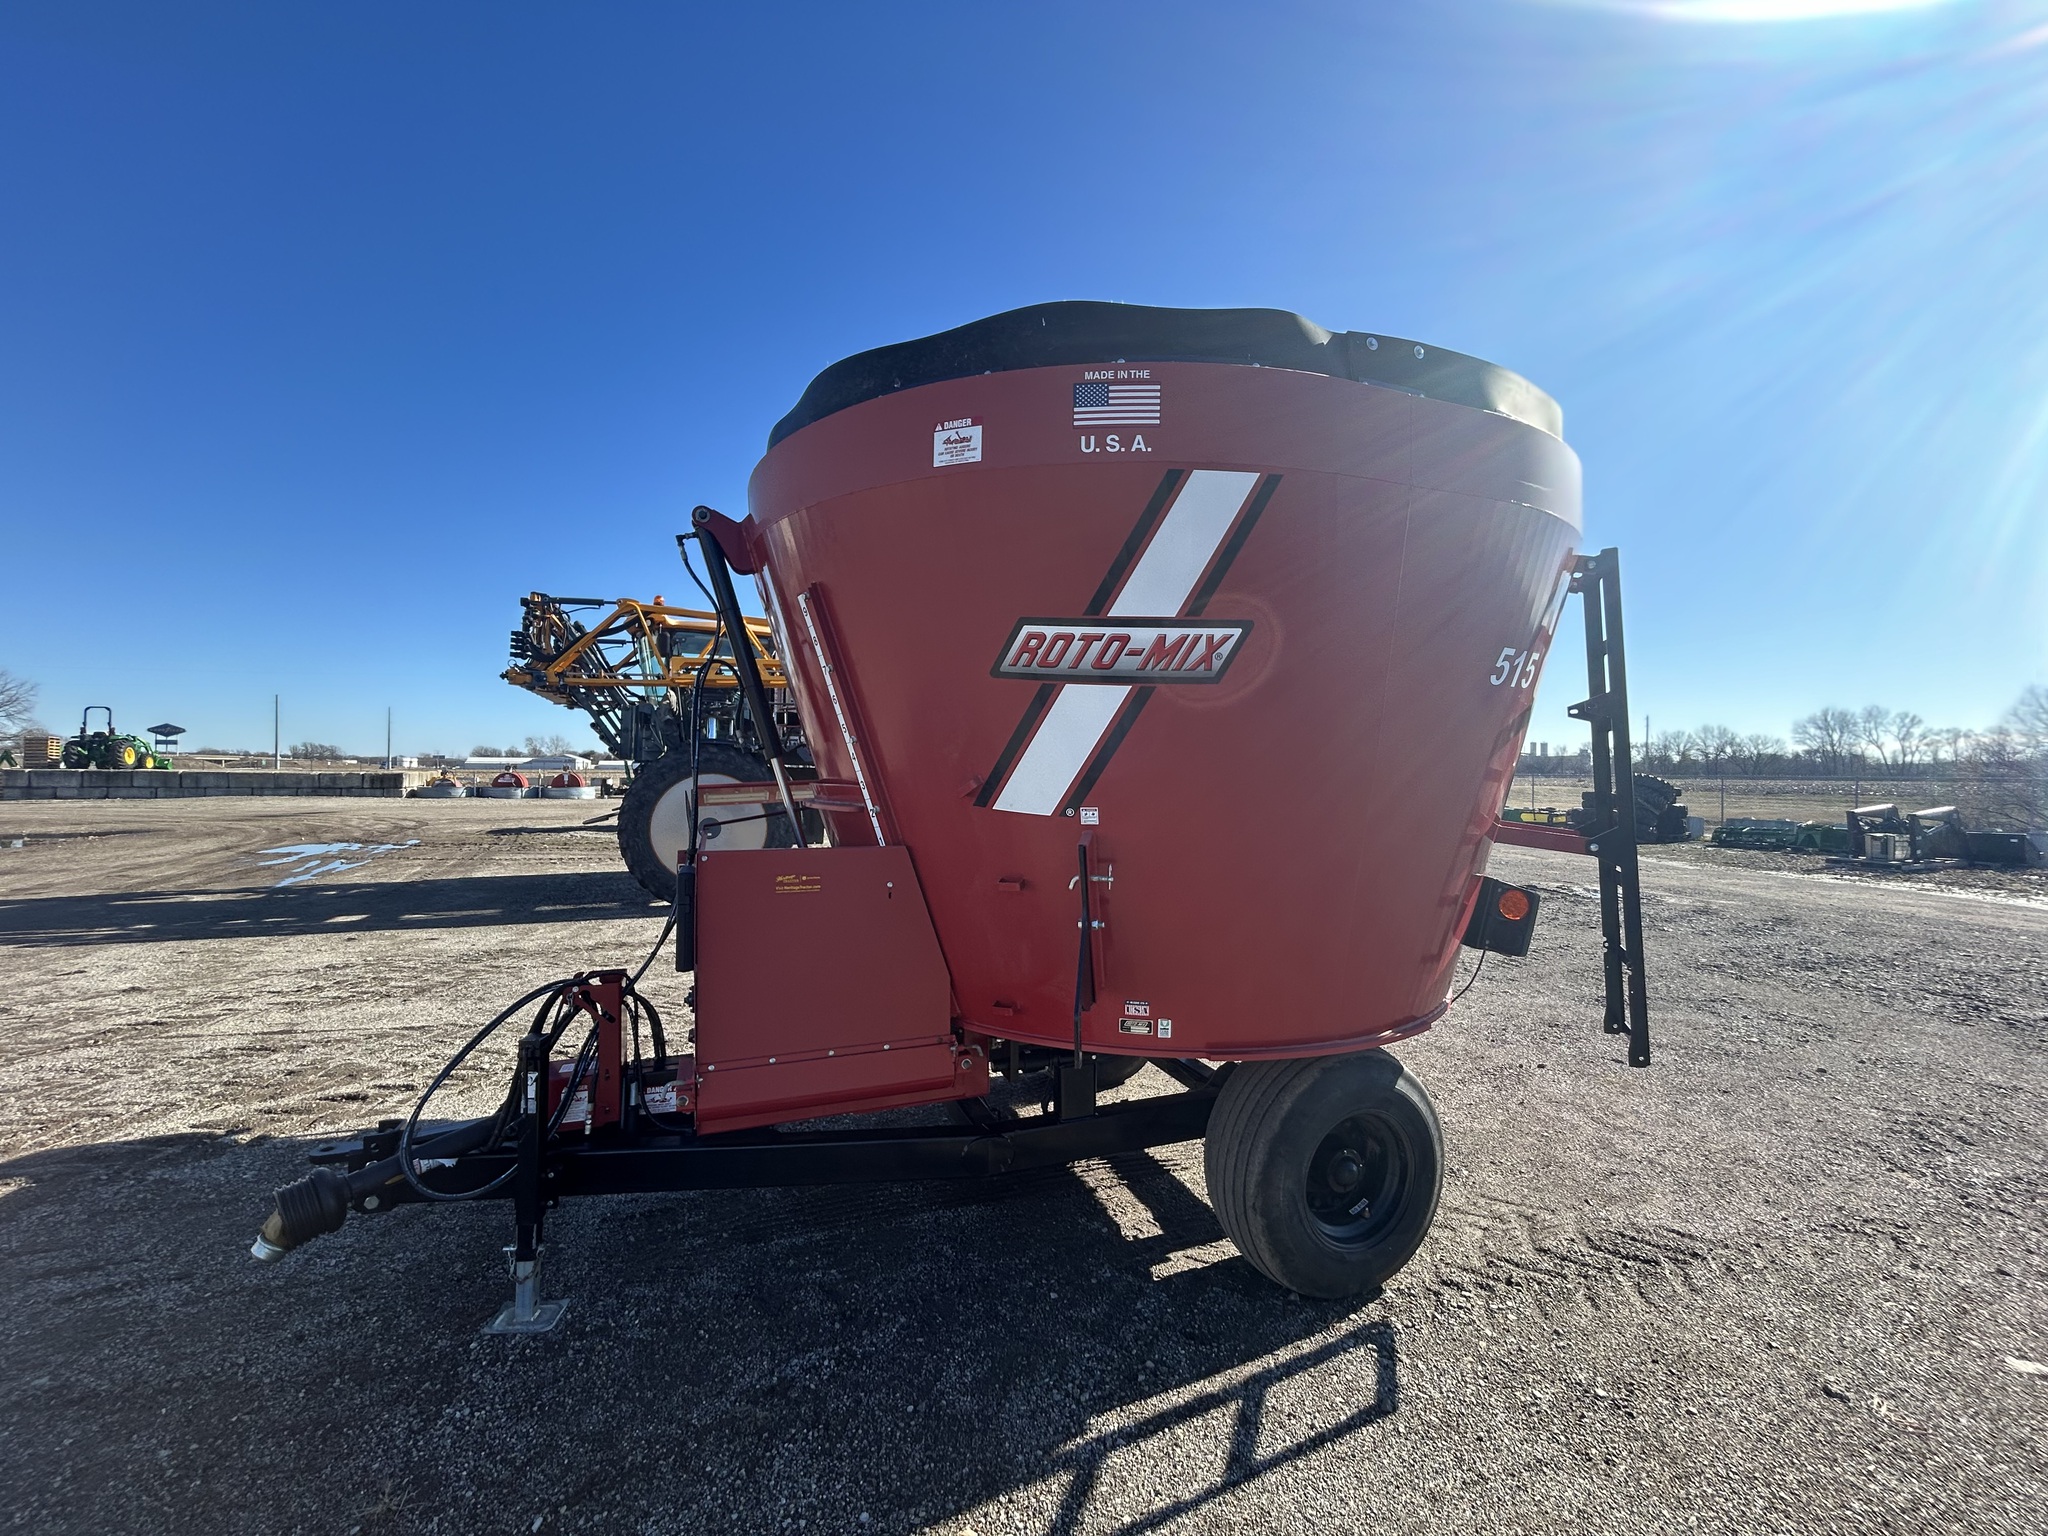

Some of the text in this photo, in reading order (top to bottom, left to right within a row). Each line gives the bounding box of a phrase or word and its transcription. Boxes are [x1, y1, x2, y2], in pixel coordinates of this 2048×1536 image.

[1084, 369, 1151, 380] MADE IN THE
[943, 418, 972, 430] DANGER
[802, 606, 808, 617] 9
[812, 635, 819, 646] 8
[1008, 630, 1235, 672] ROTO-MIX
[822, 665, 828, 675] 7
[1489, 646, 1540, 689] 515
[841, 723, 847, 733] 5
[869, 808, 876, 818] 2
[1125, 1005, 1149, 1015] USA
[646, 1085, 673, 1094] DANGR
